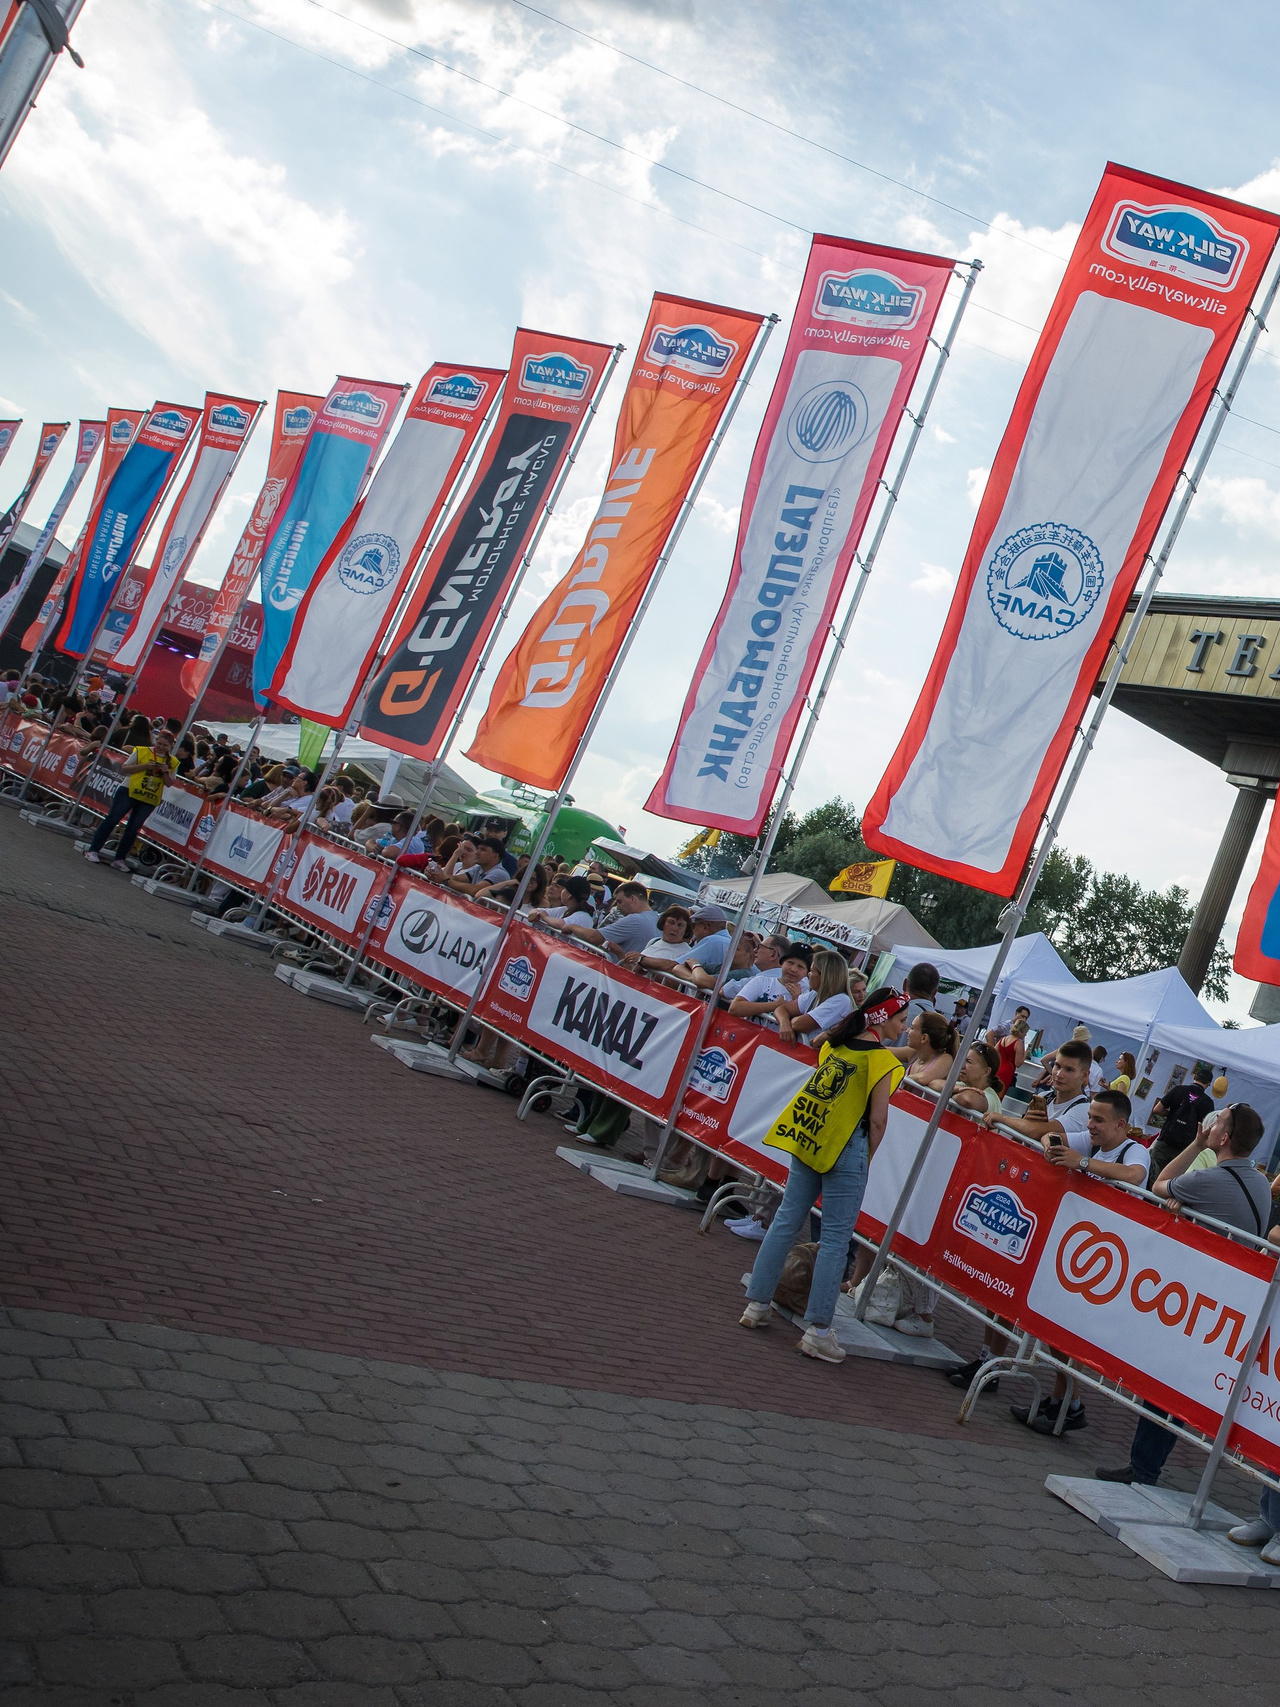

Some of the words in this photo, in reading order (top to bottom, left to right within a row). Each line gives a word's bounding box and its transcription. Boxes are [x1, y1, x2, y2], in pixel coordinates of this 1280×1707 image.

[184, 597, 213, 619] 202
[438, 930, 488, 975] LADA
[551, 976, 659, 1071] KAMAZ
[869, 1007, 889, 1020] SILK
[871, 1014, 890, 1026] WAY
[713, 1067, 732, 1081] WAY
[683, 1104, 720, 1130] kwayrally2024
[792, 1109, 824, 1137] WAY
[794, 1096, 831, 1124] SILK
[775, 1123, 823, 1156] SAFETY
[995, 1194, 1011, 1205] 2024
[970, 1197, 1000, 1222] SILK
[999, 1211, 1028, 1233] WAY
[982, 1218, 1005, 1232] RALLY
[942, 1250, 1015, 1298] #silkwayrally2024
